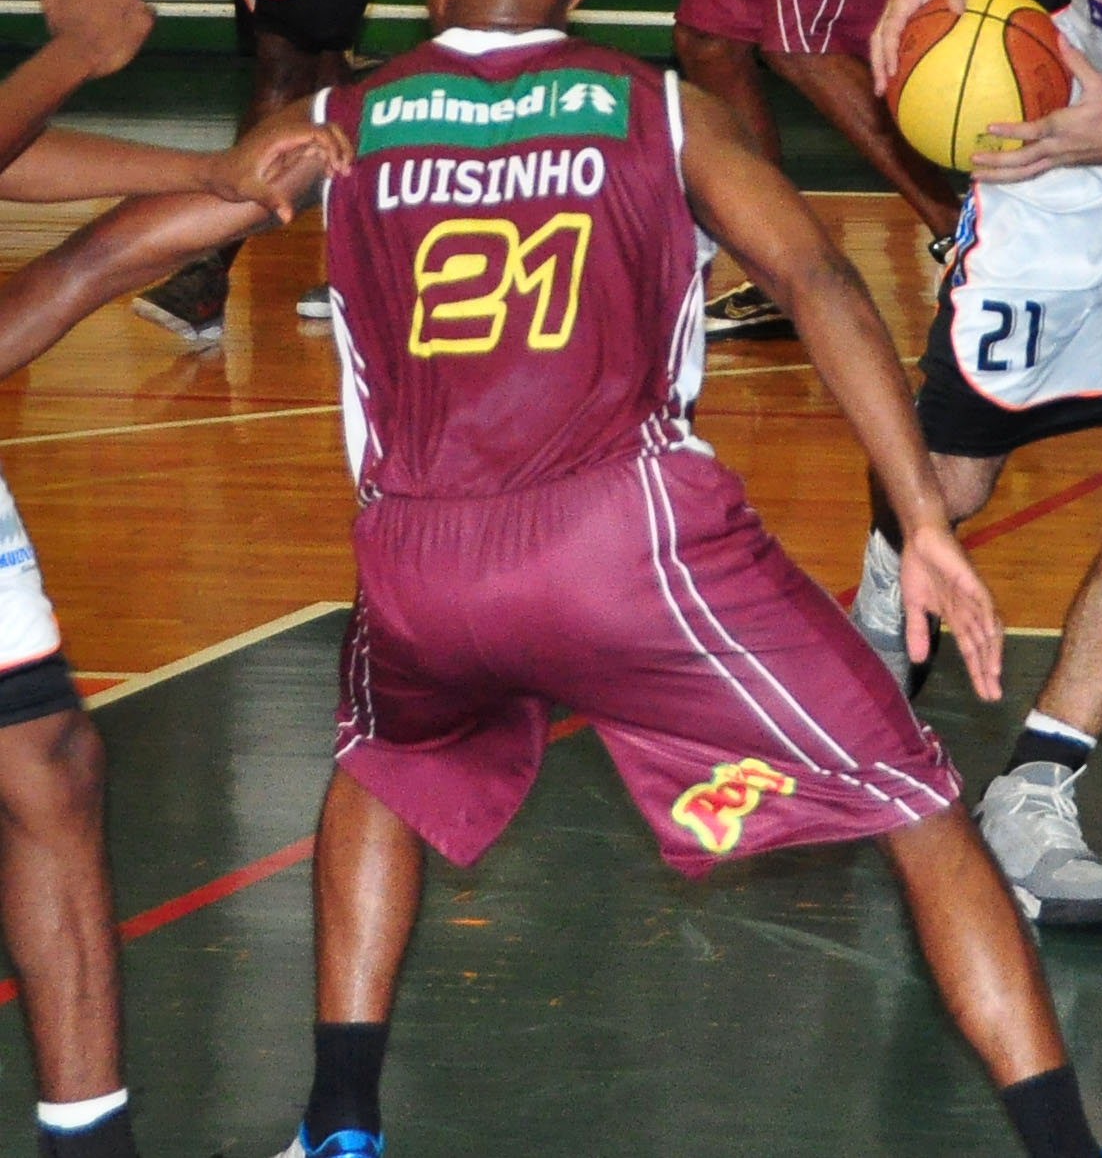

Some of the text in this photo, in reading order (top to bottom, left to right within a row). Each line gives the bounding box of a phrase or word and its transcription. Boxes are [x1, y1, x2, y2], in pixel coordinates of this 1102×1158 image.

[371, 86, 545, 125] Unimed
[377, 146, 605, 210] LUISINHO
[408, 212, 592, 357] 21
[977, 299, 1046, 371] 21
